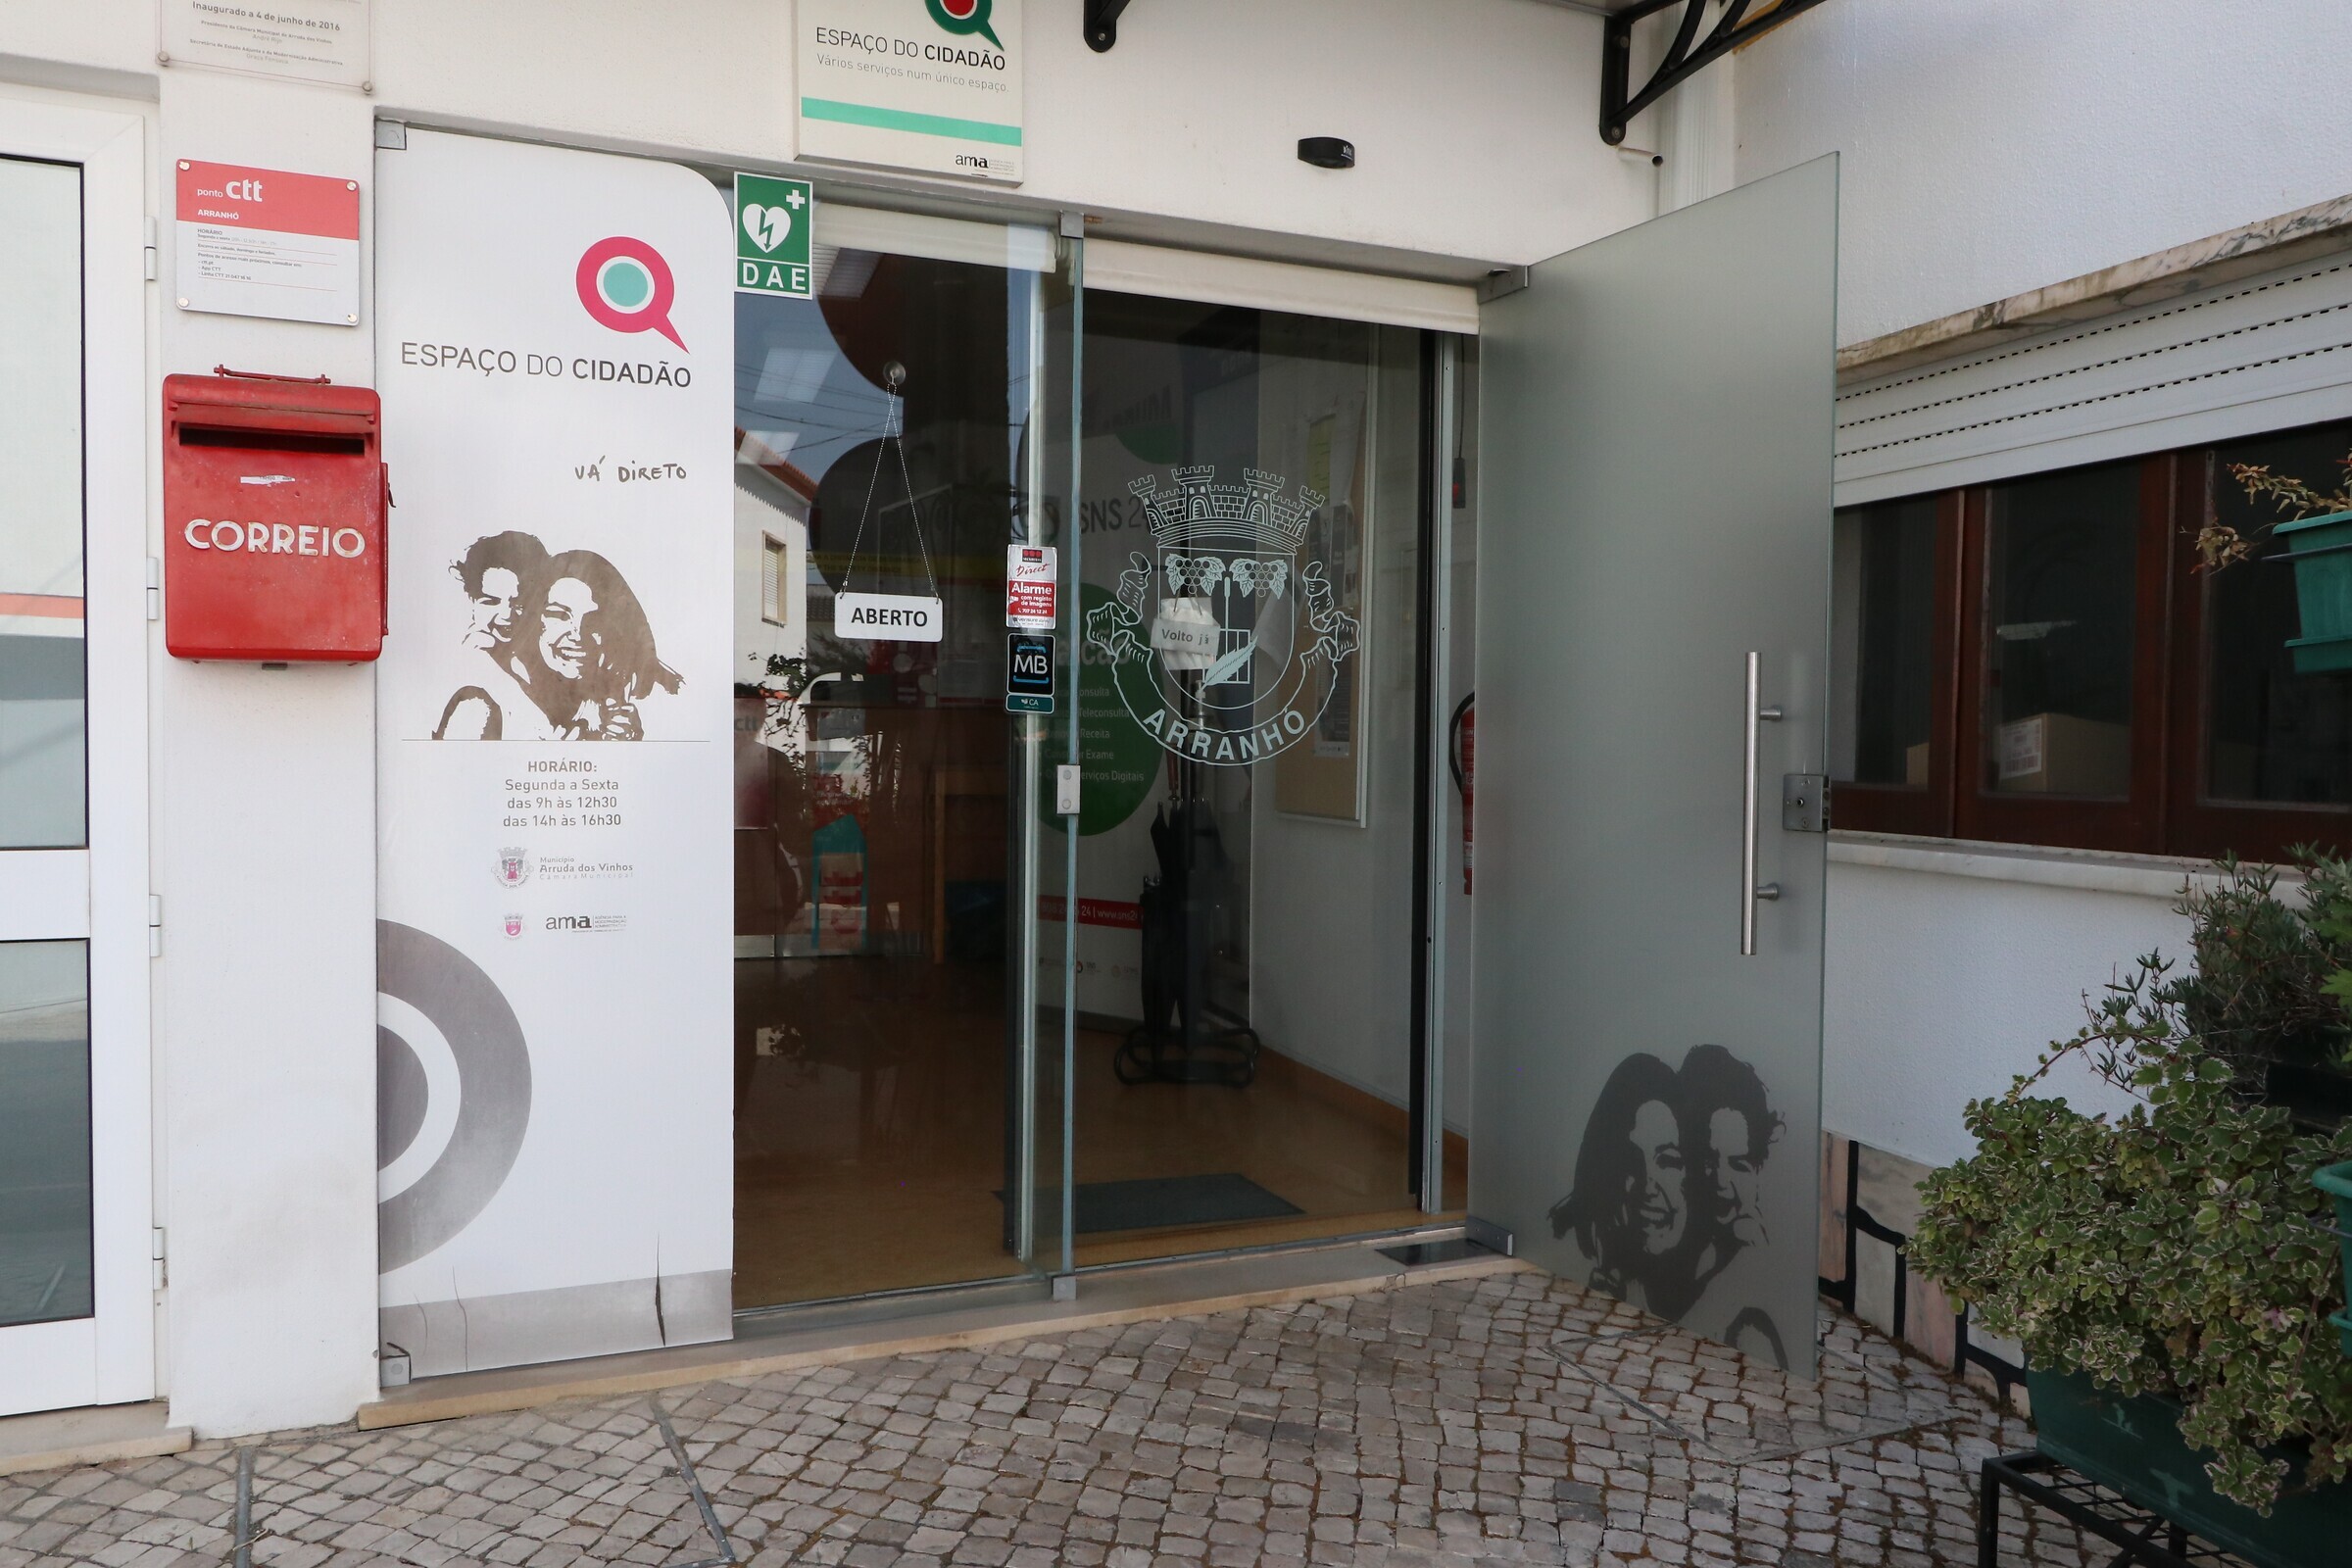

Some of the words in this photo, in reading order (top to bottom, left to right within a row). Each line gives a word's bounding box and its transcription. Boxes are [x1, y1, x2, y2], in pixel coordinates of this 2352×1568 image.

[192, 1, 246, 17] Inaugurado
[264, 12, 275, 21] de
[277, 14, 303, 25] junho
[305, 18, 317, 27] de
[318, 21, 341, 31] 2016
[816, 26, 888, 55] ESPAÇO
[894, 39, 918, 58] DO
[924, 44, 1005, 71] CIDADÃO
[816, 53, 854, 70] Vários
[857, 61, 904, 78] serviços
[906, 70, 932, 81] num
[935, 72, 965, 87] único
[968, 79, 1009, 94] espaço.
[955, 154, 989, 169] ama
[197, 188, 223, 198] ponto
[225, 179, 263, 202] ctt
[197, 209, 240, 220] ARRANHÓ
[743, 262, 806, 291] DAE
[401, 342, 516, 377] ESPAÇO
[527, 354, 563, 377] DO
[572, 358, 691, 388] CIDADÃO
[575, 455, 606, 482] VÁ
[184, 519, 365, 558] CORREIO
[1016, 564, 1051, 577] Direct
[1011, 582, 1052, 594] Alarme
[851, 607, 928, 627] ABERTO
[1162, 629, 1193, 642] Volto
[1014, 654, 1048, 674] MB
[1079, 687, 1110, 697] onsulta
[1080, 728, 1110, 739] Receita
[1143, 708, 1305, 760] ARRANHÓ
[1086, 749, 1114, 760] Exame
[528, 758, 597, 772] HORÁRIO:
[1081, 770, 1110, 782] erviços
[1111, 770, 1145, 783] Digitais
[505, 779, 565, 793] Segunda
[570, 782, 577, 790] a
[582, 779, 619, 790] Sexta
[507, 797, 532, 808] das
[536, 797, 552, 808] 9h
[557, 796, 572, 808] às
[577, 796, 617, 808] 12h30
[503, 815, 527, 827] das
[533, 815, 557, 827] 14h
[561, 814, 576, 826] às
[582, 814, 621, 826] 16h30
[539, 864, 575, 873] Arruda
[578, 864, 595, 872] dos
[598, 863, 634, 872] Vinhos
[1082, 906, 1092, 916] 24
[545, 915, 592, 930] ama
